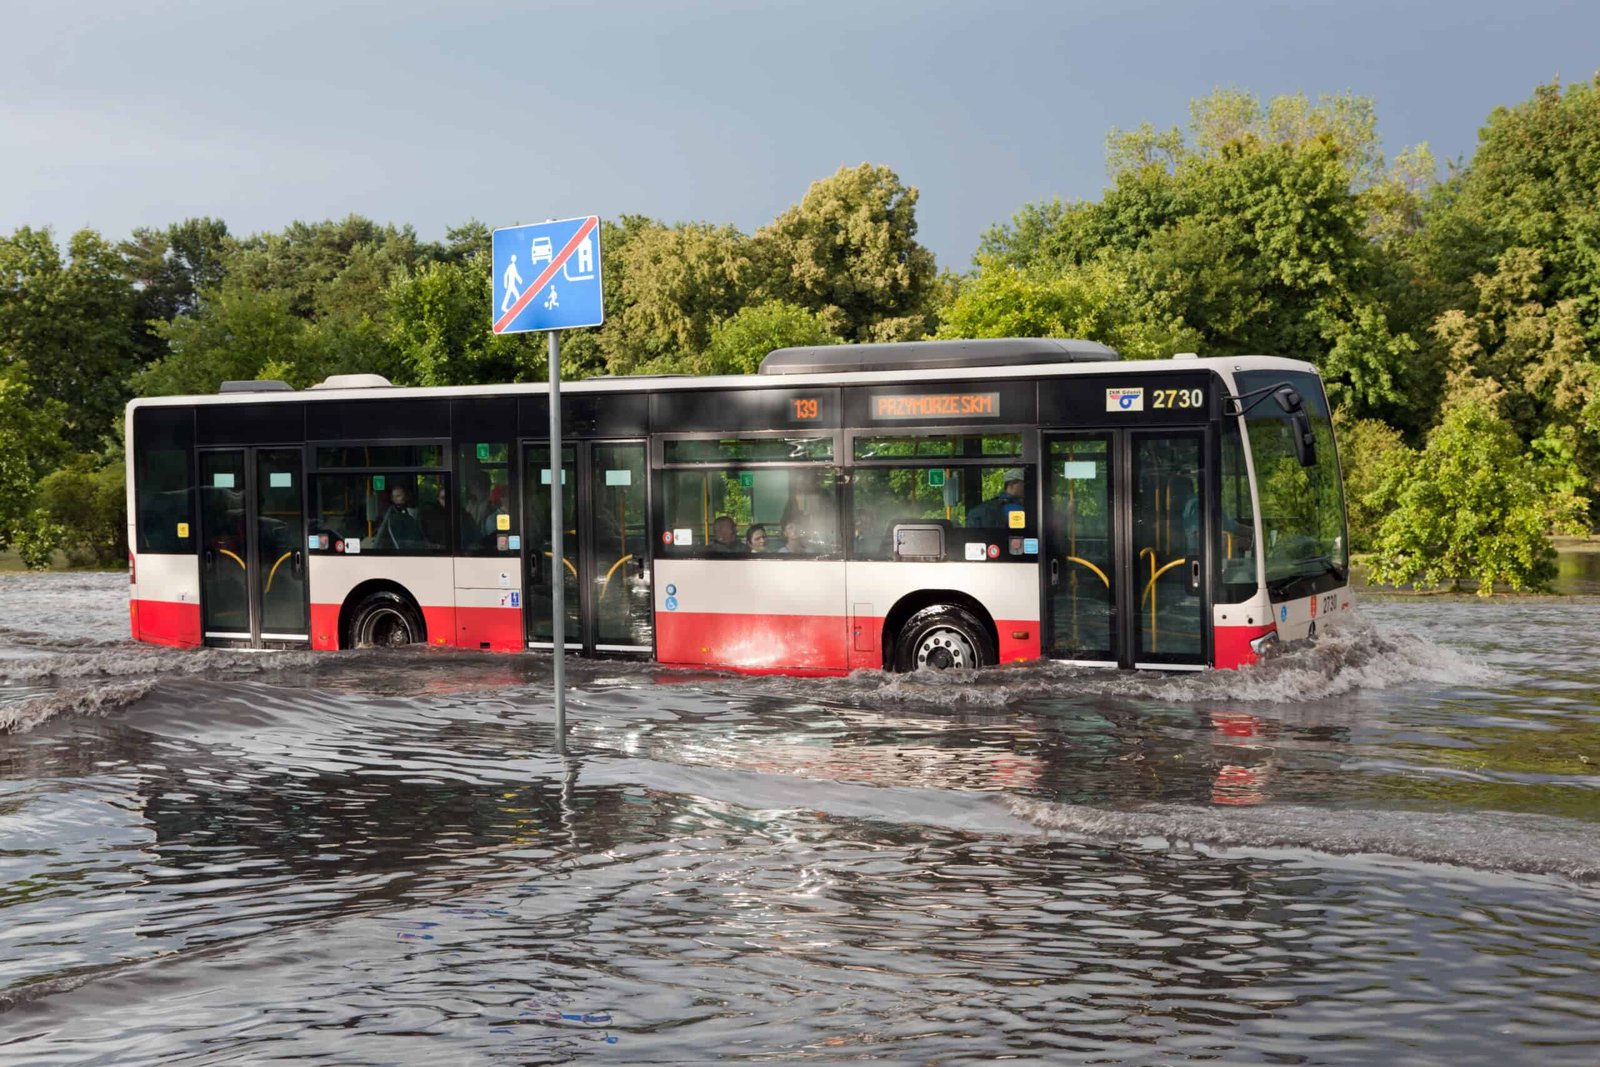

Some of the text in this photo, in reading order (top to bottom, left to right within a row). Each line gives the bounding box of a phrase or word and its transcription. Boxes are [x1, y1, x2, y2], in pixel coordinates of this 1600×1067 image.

[878, 395, 992, 416] PRZYMORZE SKM
[1153, 389, 1203, 408] 2730
[794, 399, 818, 418] 139
[1323, 594, 1337, 614] 2730
